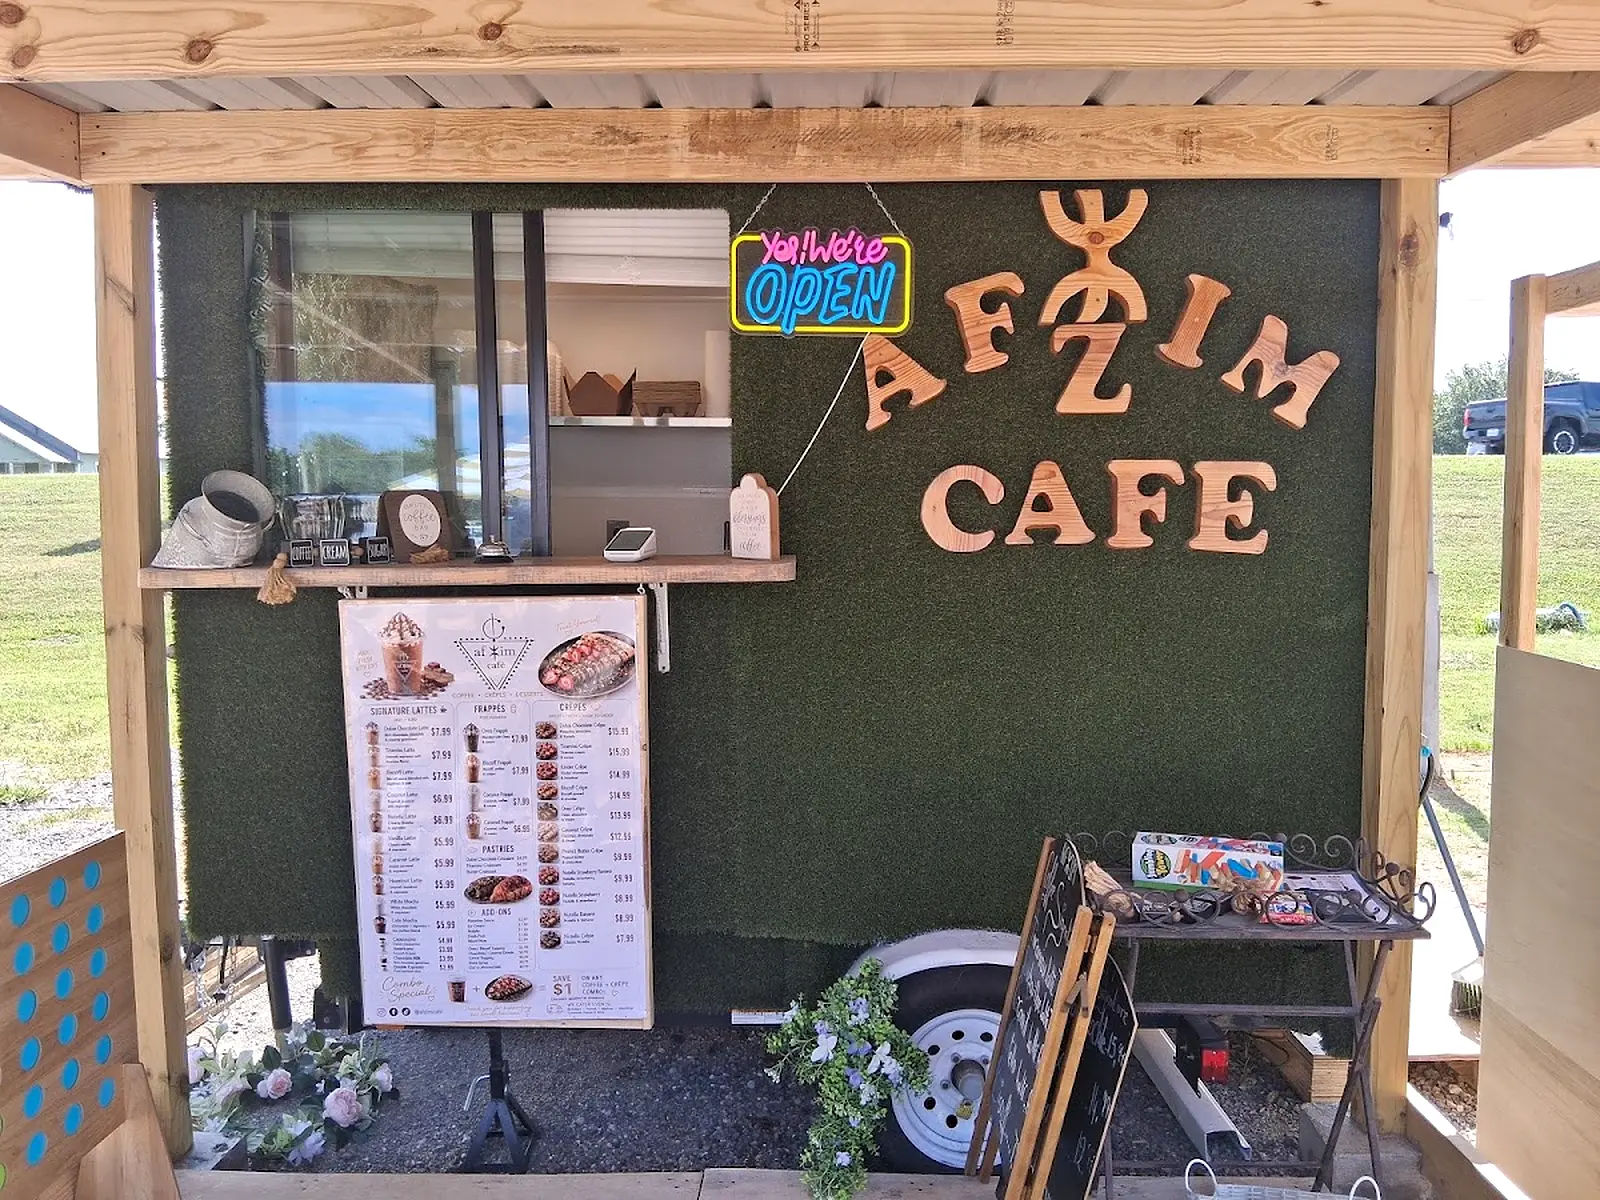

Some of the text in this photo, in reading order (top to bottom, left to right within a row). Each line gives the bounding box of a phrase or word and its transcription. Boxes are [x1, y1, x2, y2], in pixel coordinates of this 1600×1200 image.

[745, 263, 896, 335] OPEN
[920, 459, 1278, 555] CAFE
[292, 546, 312, 561] COFFEE
[323, 544, 348, 560] CREAM
[370, 705, 438, 716] SIGNATURE LATTES
[431, 727, 451, 737] $7.99
[511, 734, 528, 744] $7.99
[431, 750, 452, 760] $7.99
[608, 747, 630, 757] $15.99
[432, 771, 453, 781] $7.99
[512, 766, 529, 776] $7.99
[608, 770, 630, 779] $14.99
[432, 794, 453, 804] $6.99
[609, 791, 631, 800] $14.99
[513, 797, 530, 806] $7.99
[610, 811, 631, 820] $13.99
[434, 837, 454, 847] $5.99
[482, 845, 515, 854] PASTRIES
[613, 852, 632, 862] $9.99
[434, 858, 454, 868] $5.99
[614, 874, 633, 883] $9.99
[435, 879, 455, 889] $5.99
[435, 900, 455, 910] $5.99
[615, 914, 634, 923] $8.99
[436, 920, 455, 929] $5.99
[616, 934, 634, 944] $7.99
[382, 976, 425, 991] Combo
[387, 985, 433, 1002] Special
[553, 983, 572, 996] $1
